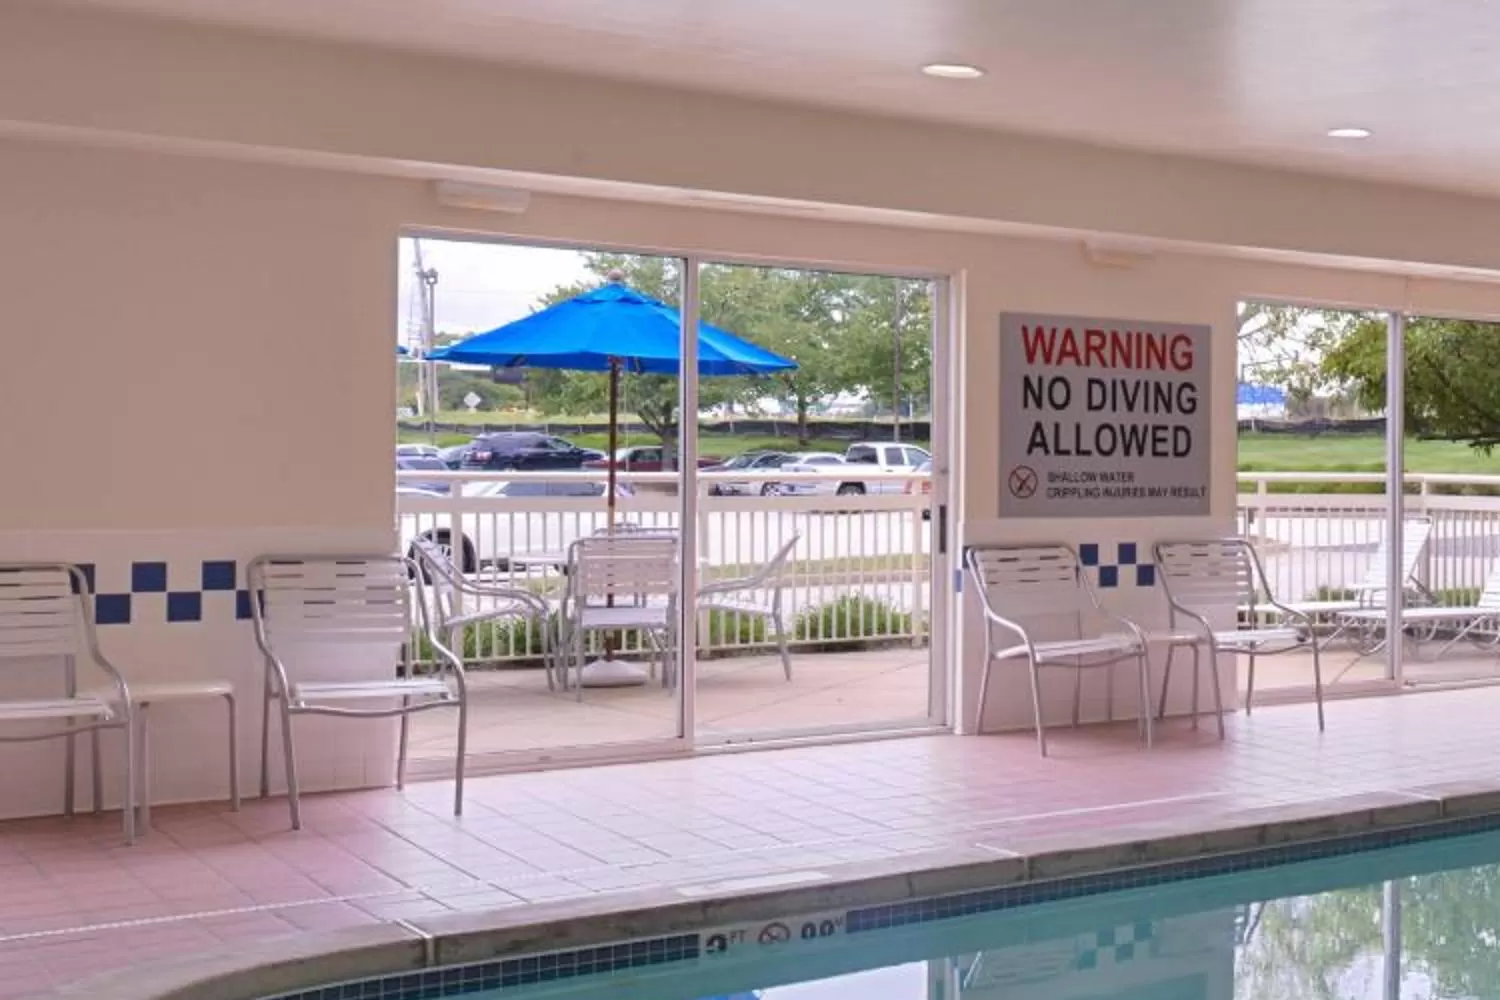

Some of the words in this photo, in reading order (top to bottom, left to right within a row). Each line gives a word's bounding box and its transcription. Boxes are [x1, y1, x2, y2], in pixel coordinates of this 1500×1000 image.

[1021, 324, 1194, 372] WARNING
[1023, 374, 1072, 411] NO
[1086, 377, 1198, 415] DIVING
[1026, 421, 1193, 458] ALLOWED
[1047, 471, 1097, 483] SHALLOW
[1099, 471, 1136, 483] WATER
[1148, 486, 1170, 498] MAY
[1171, 485, 1207, 498] RESULT
